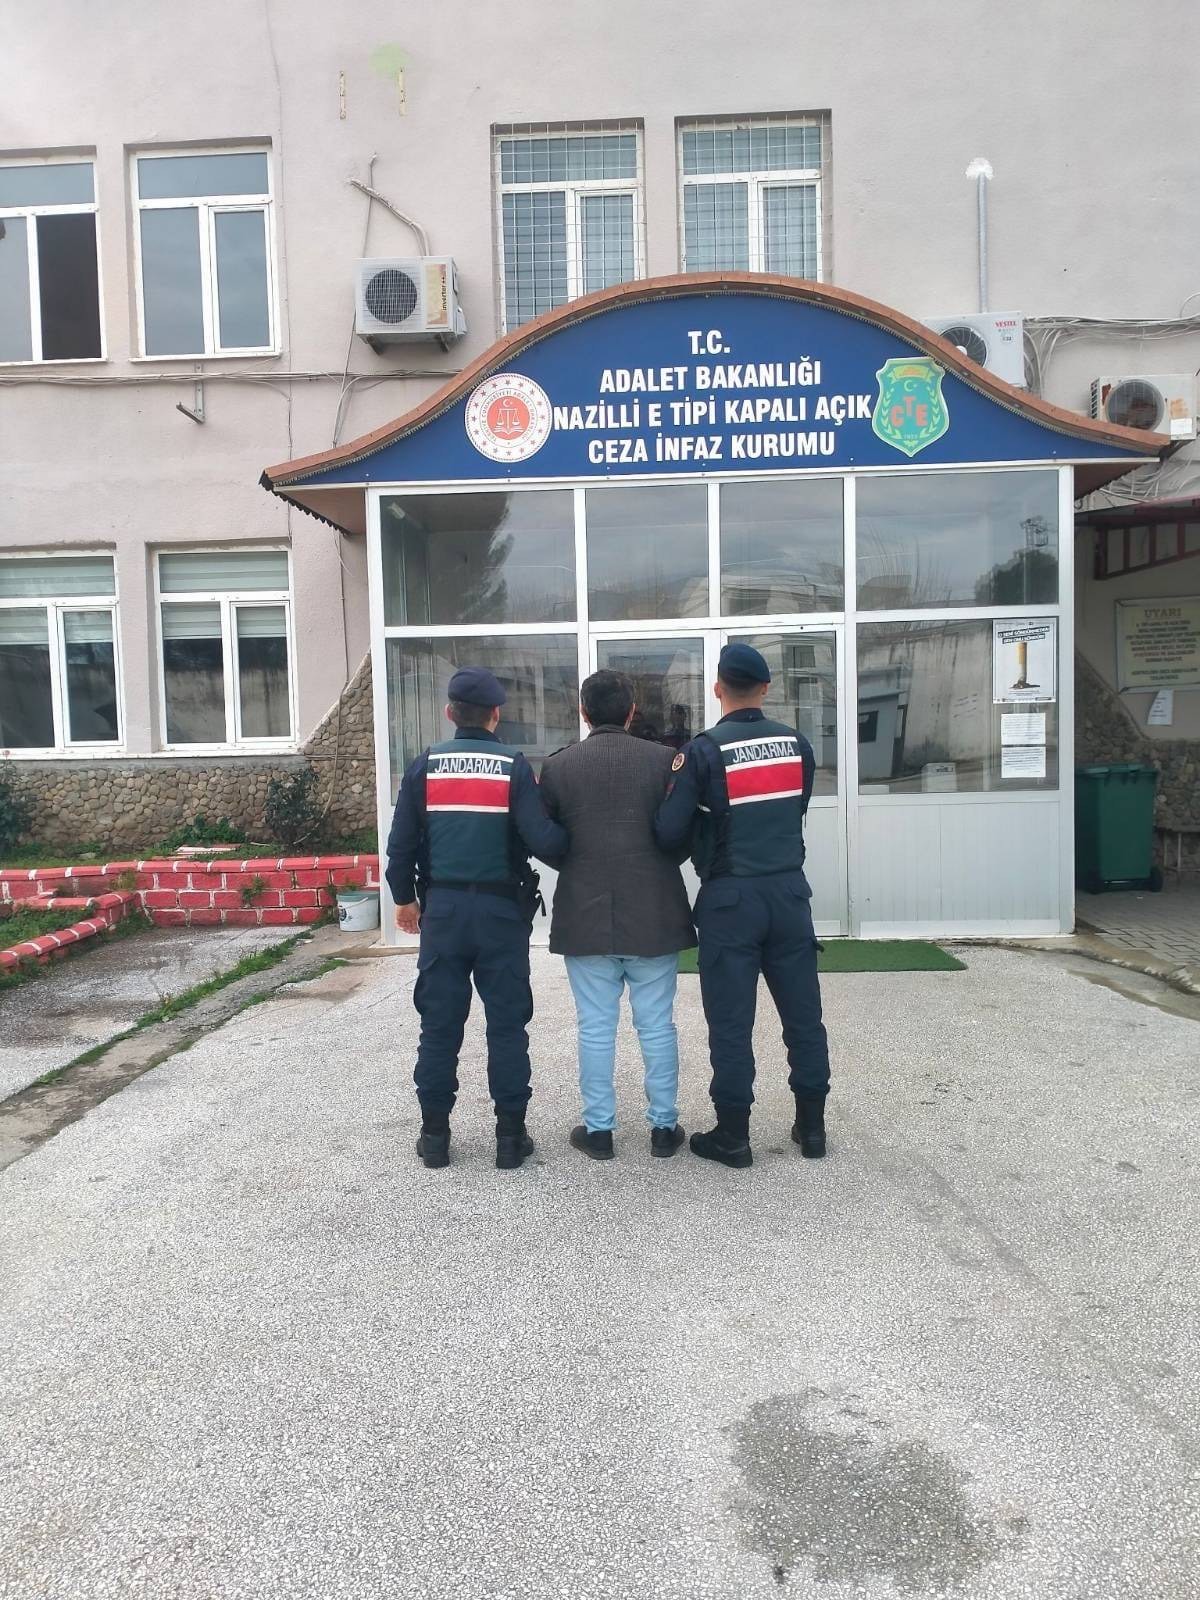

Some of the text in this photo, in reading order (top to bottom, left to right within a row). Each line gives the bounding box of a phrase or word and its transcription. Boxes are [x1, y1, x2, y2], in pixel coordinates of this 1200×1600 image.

[688, 330, 730, 355] T.C.
[600, 356, 821, 393] ADALET BAKANLIĞI
[553, 394, 872, 430] NAZİLLİ E TİPİ KAPALI AÇIK
[588, 431, 835, 464] CEZA İNFAZ KURUMU
[1144, 607, 1182, 618] UYARI
[732, 741, 796, 763] JANDARMA
[434, 758, 503, 774] JANDARMA
